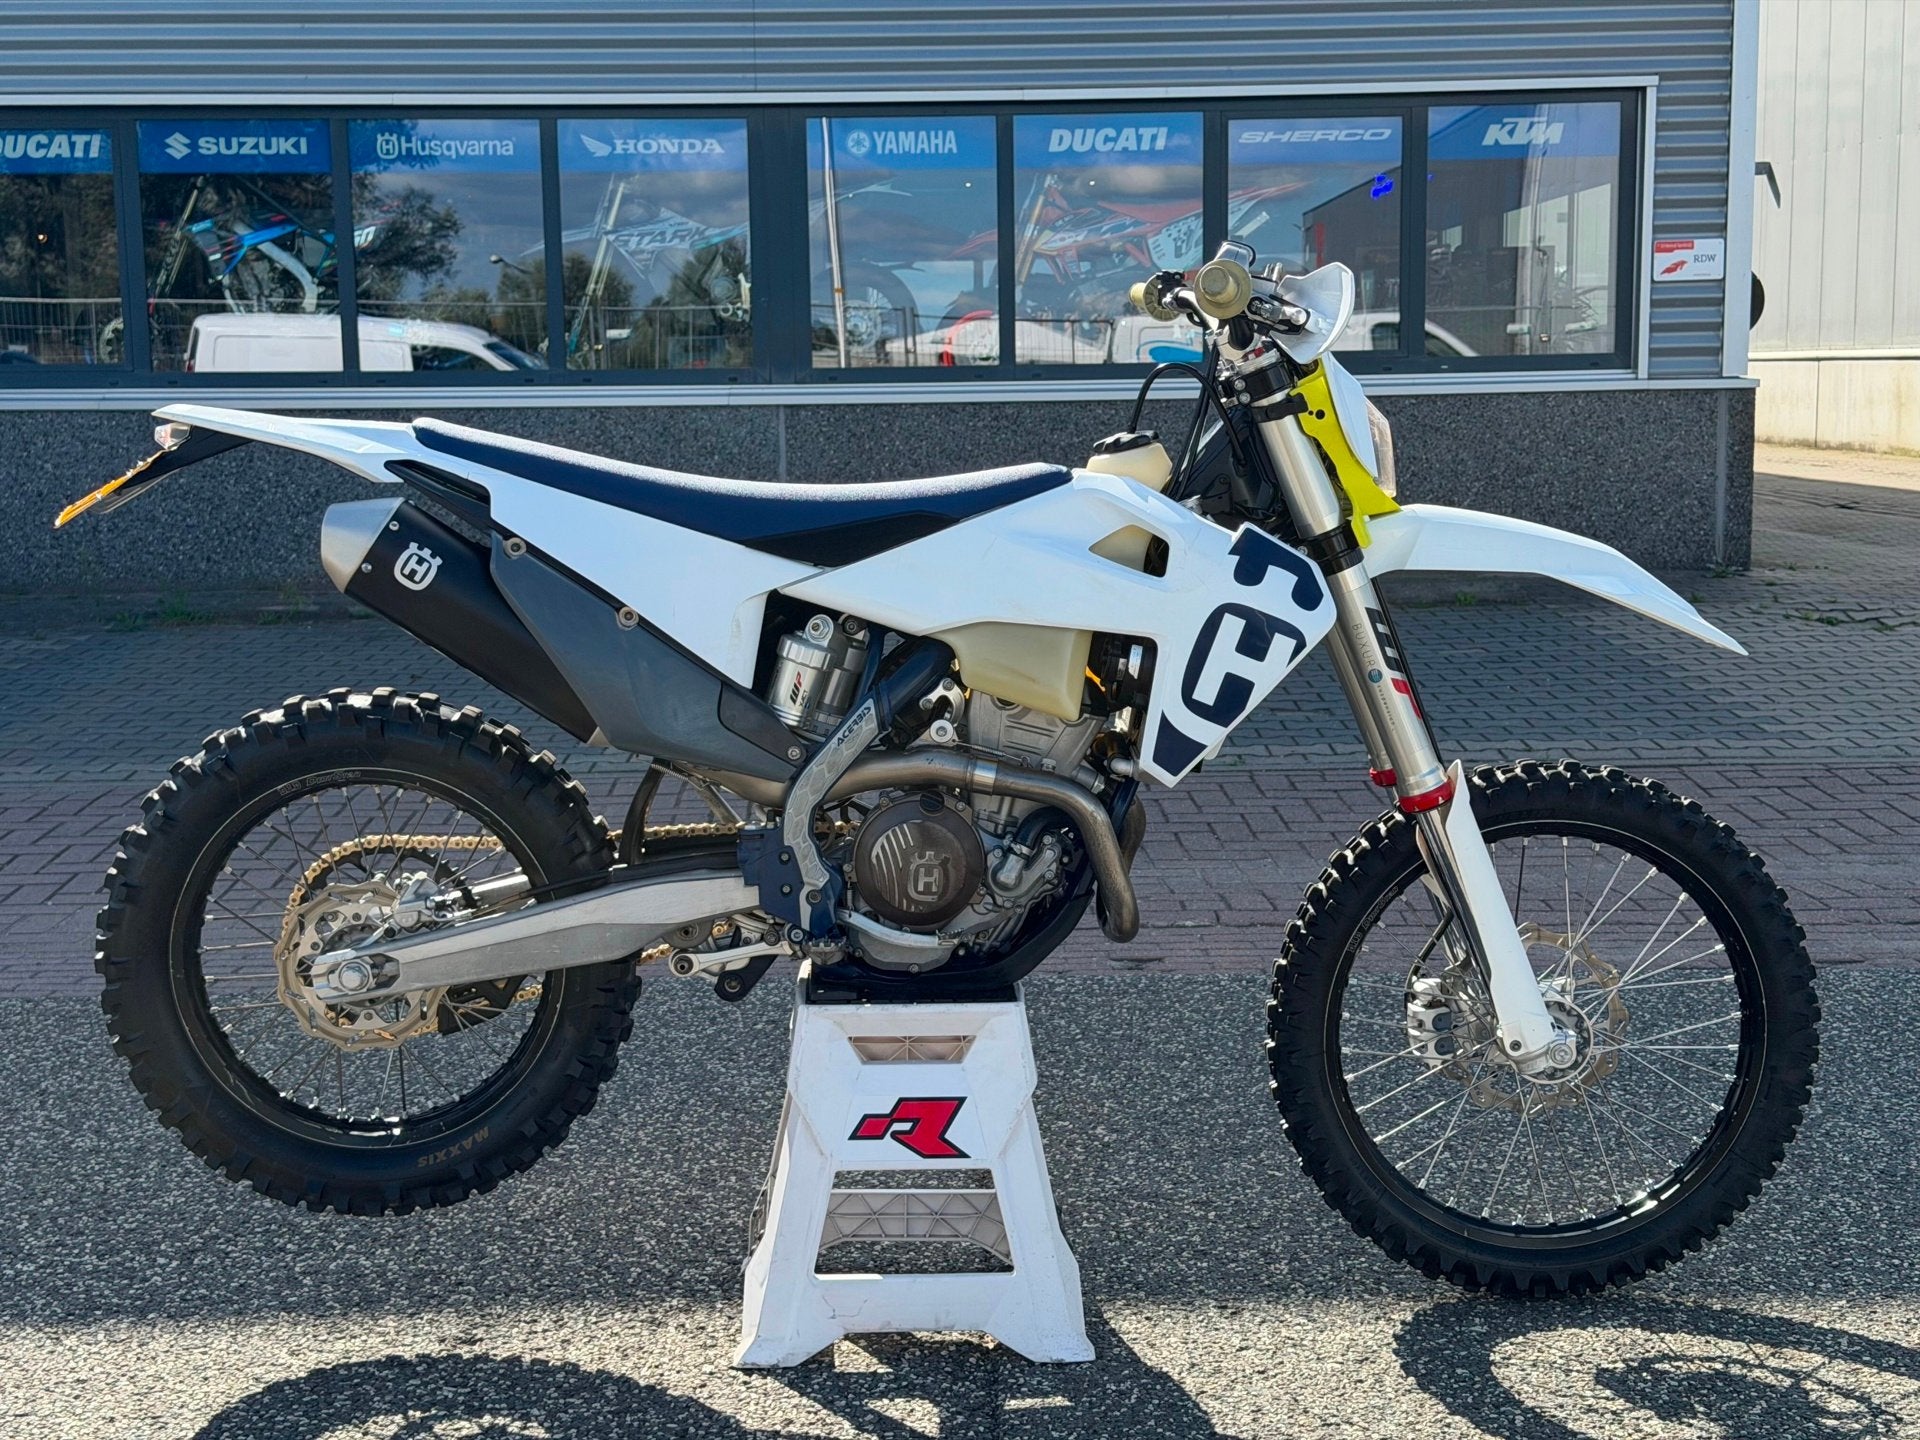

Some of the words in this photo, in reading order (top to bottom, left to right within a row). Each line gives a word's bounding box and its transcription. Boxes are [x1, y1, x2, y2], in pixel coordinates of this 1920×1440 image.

[873, 130, 958, 154] YAMAHA
[1048, 127, 1169, 153] DUCATI
[1238, 128, 1392, 144] SHERCO
[1481, 117, 1564, 146] KTM
[0, 134, 102, 158] UCATI
[198, 136, 308, 155] SUZUKI
[401, 136, 514, 158] Husqvarna
[613, 138, 725, 155] HONDA
[1693, 254, 1717, 264] RDW
[836, 706, 872, 747] ACERBIS
[417, 1126, 489, 1168] MAXXIS
